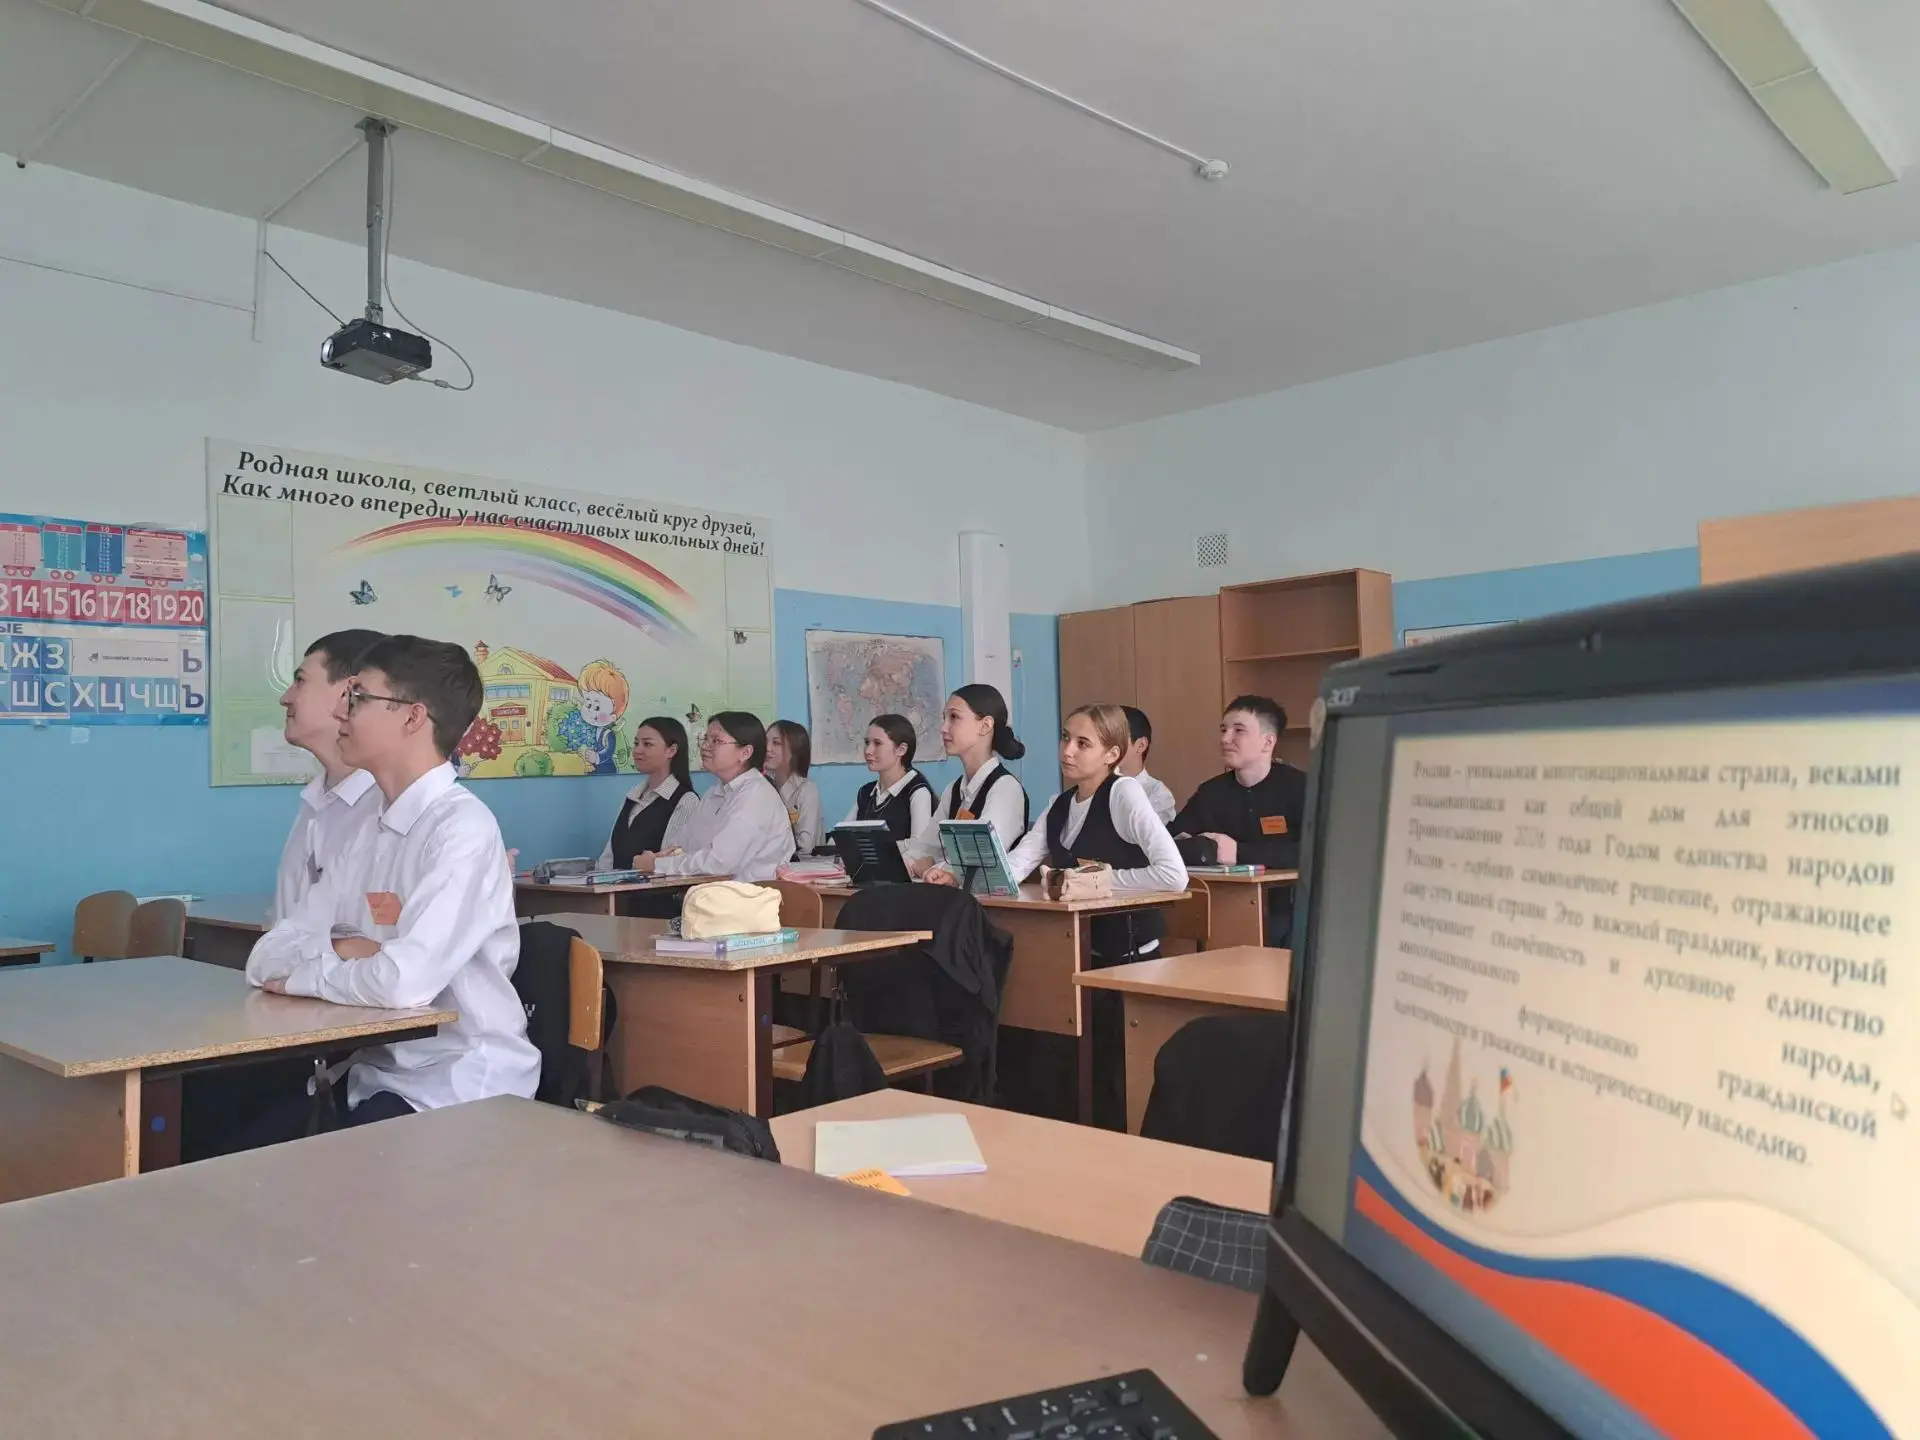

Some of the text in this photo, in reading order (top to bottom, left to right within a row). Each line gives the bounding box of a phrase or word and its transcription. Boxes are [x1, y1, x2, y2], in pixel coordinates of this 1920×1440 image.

[222, 474, 765, 557] Как много впереди у нас счастливых школьных дней!
[237, 450, 756, 538] Родная школа, светлый класс, весёлый круг друзей,
[12, 585, 40, 613] 14
[43, 586, 68, 615] 15
[70, 589, 96, 617] 16
[99, 590, 124, 618] 17
[125, 592, 151, 620] 18
[152, 594, 178, 621] 19
[179, 596, 204, 622] 20
[12, 642, 39, 668] Ж
[1718, 764, 1797, 790] страна,
[1808, 764, 1901, 787] веками
[1569, 795, 1623, 820] общий
[1648, 806, 1686, 825] дом
[1714, 808, 1752, 828] для
[1786, 811, 1890, 837] этносов
[1558, 835, 1592, 854] года
[1604, 834, 1661, 862] Годом
[1674, 846, 1768, 873] единства
[1787, 856, 1896, 887] народов
[1630, 881, 1719, 916] решение,
[1732, 895, 1892, 937] отражающее
[1553, 900, 1584, 928] Это
[1592, 911, 1660, 944] важный
[1665, 927, 1768, 969] праздник,
[1774, 946, 1888, 987] который
[1644, 966, 1736, 1003] духовное
[1766, 992, 1886, 1038] единство
[1781, 1041, 1881, 1093] народа,
[1717, 1069, 1878, 1140] гражданской
